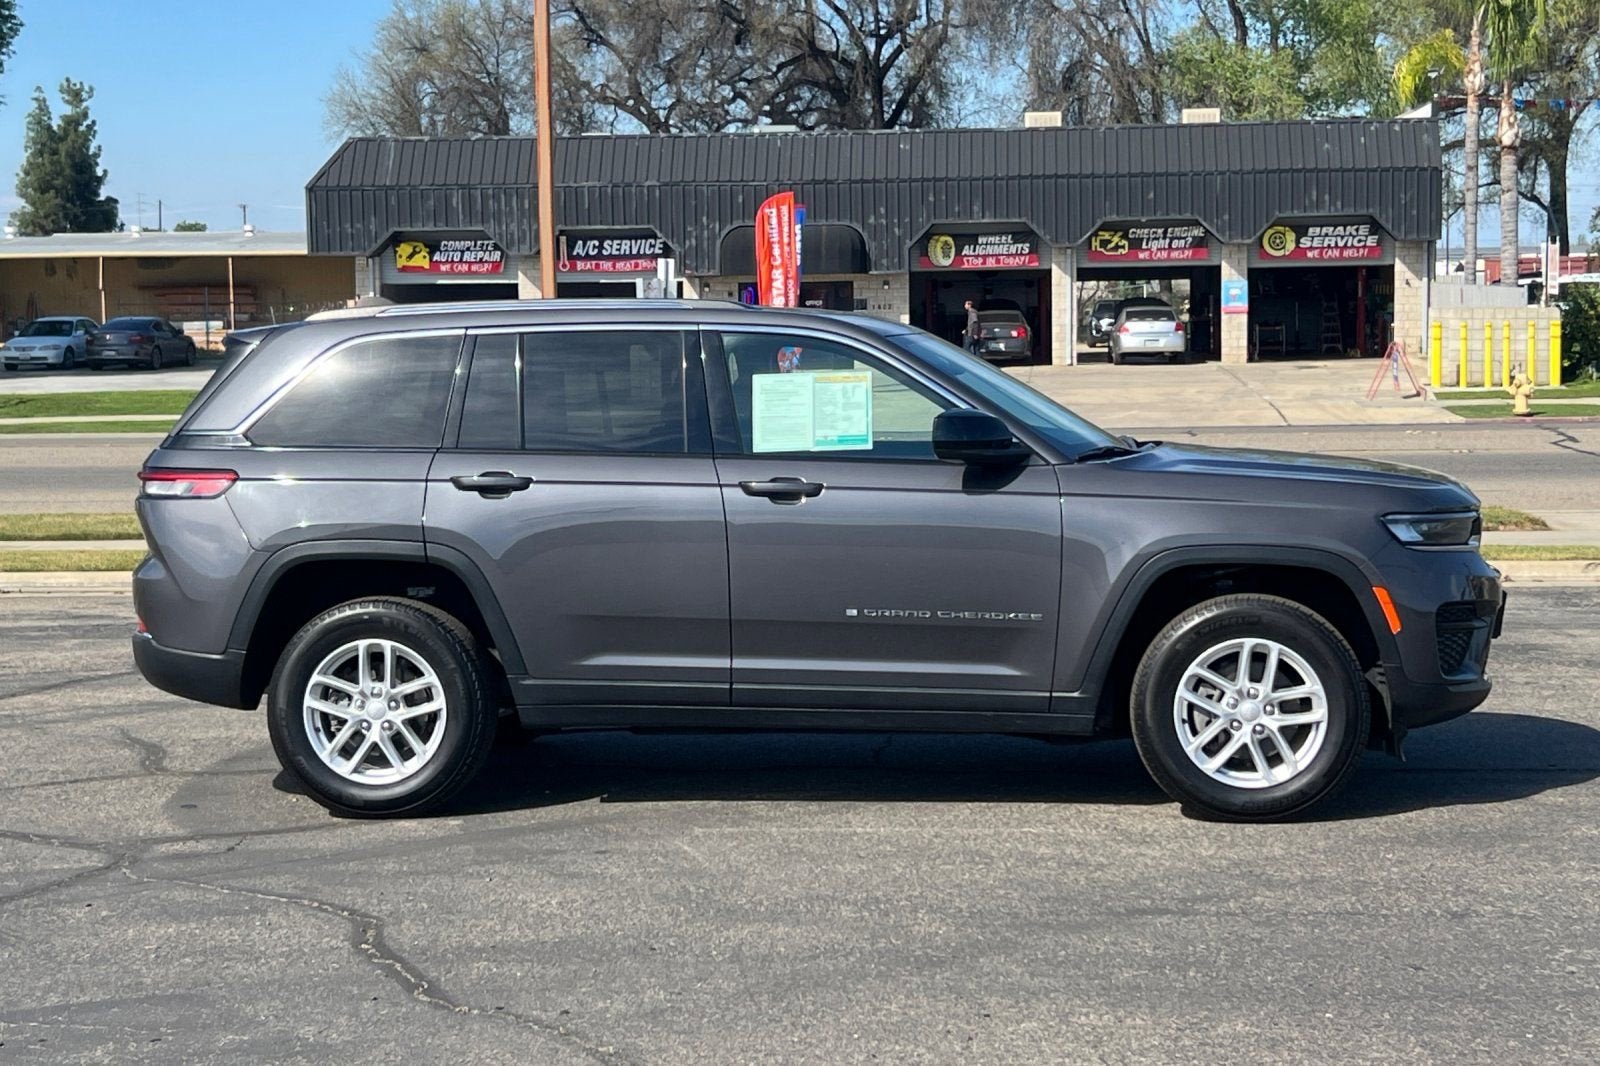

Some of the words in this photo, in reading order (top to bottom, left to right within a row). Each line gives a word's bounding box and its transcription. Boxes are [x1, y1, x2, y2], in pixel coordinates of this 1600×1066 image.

[764, 207, 781, 266] Certified
[1128, 227, 1165, 238] CHECK
[1167, 225, 1206, 237] ENGINE
[1307, 225, 1370, 237] BRAKE
[977, 234, 1014, 244] WHEEL
[1141, 238, 1170, 252] Light
[1171, 237, 1193, 249] on?
[1298, 235, 1379, 248] SERVICE
[440, 240, 496, 251] COMPLETE
[572, 239, 600, 256] A/C
[602, 238, 664, 255] SERVICE
[961, 243, 1031, 256] ALIGNMENTS
[433, 250, 460, 262] AUTO
[462, 250, 502, 263] REPAIR
[1138, 250, 1151, 259] WE
[1152, 249, 1168, 260] CAN
[1170, 249, 1193, 259] HELP!
[1306, 248, 1320, 258] WE
[1322, 248, 1340, 259] CAN
[1343, 248, 1368, 258] HELP!
[576, 260, 597, 271] BEAT
[599, 260, 614, 271] THE
[616, 260, 637, 271] HEAT
[638, 259, 658, 270] TODA
[962, 256, 984, 267] STOP
[986, 256, 997, 266] IN
[998, 255, 1030, 265] TODAY!
[440, 263, 452, 272] WE
[453, 263, 470, 273] CAN
[864, 608, 931, 618] GRAND
[937, 610, 1044, 621] CHEROKEE
